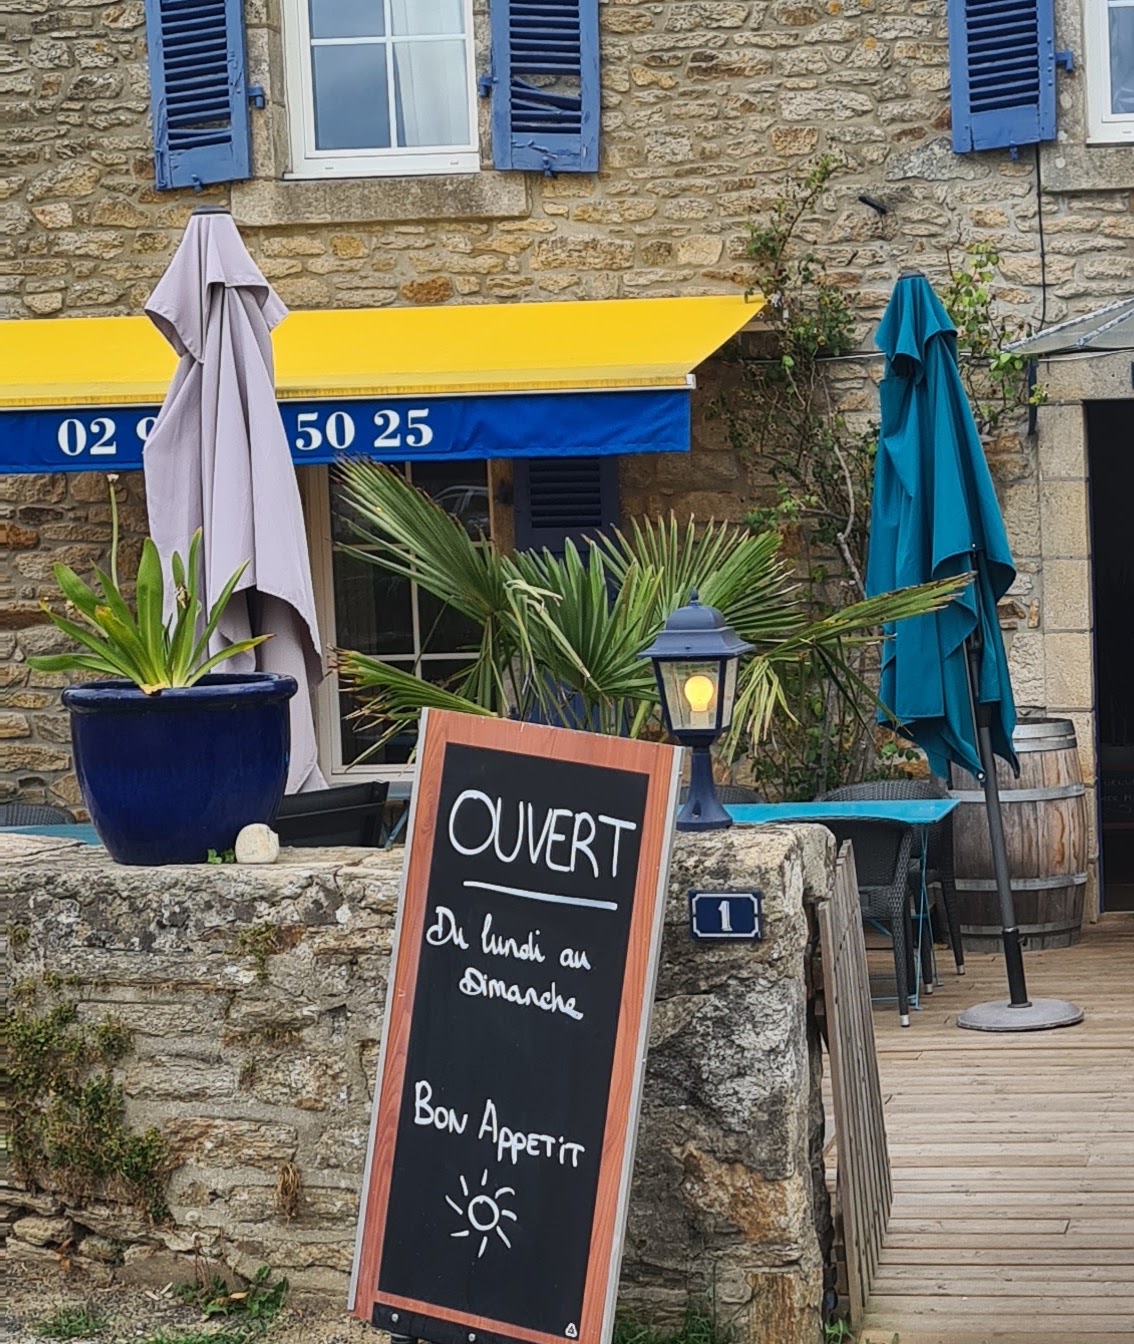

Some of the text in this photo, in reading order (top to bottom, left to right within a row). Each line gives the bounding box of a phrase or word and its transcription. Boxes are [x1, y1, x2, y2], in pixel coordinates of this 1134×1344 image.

[58, 418, 117, 456] 02
[295, 411, 356, 451] 50
[374, 408, 434, 447] 25
[448, 788, 637, 879] OUVERT
[426, 906, 592, 970] Du lundi au
[717, 900, 733, 932] 1
[459, 968, 584, 1021] Dimanche
